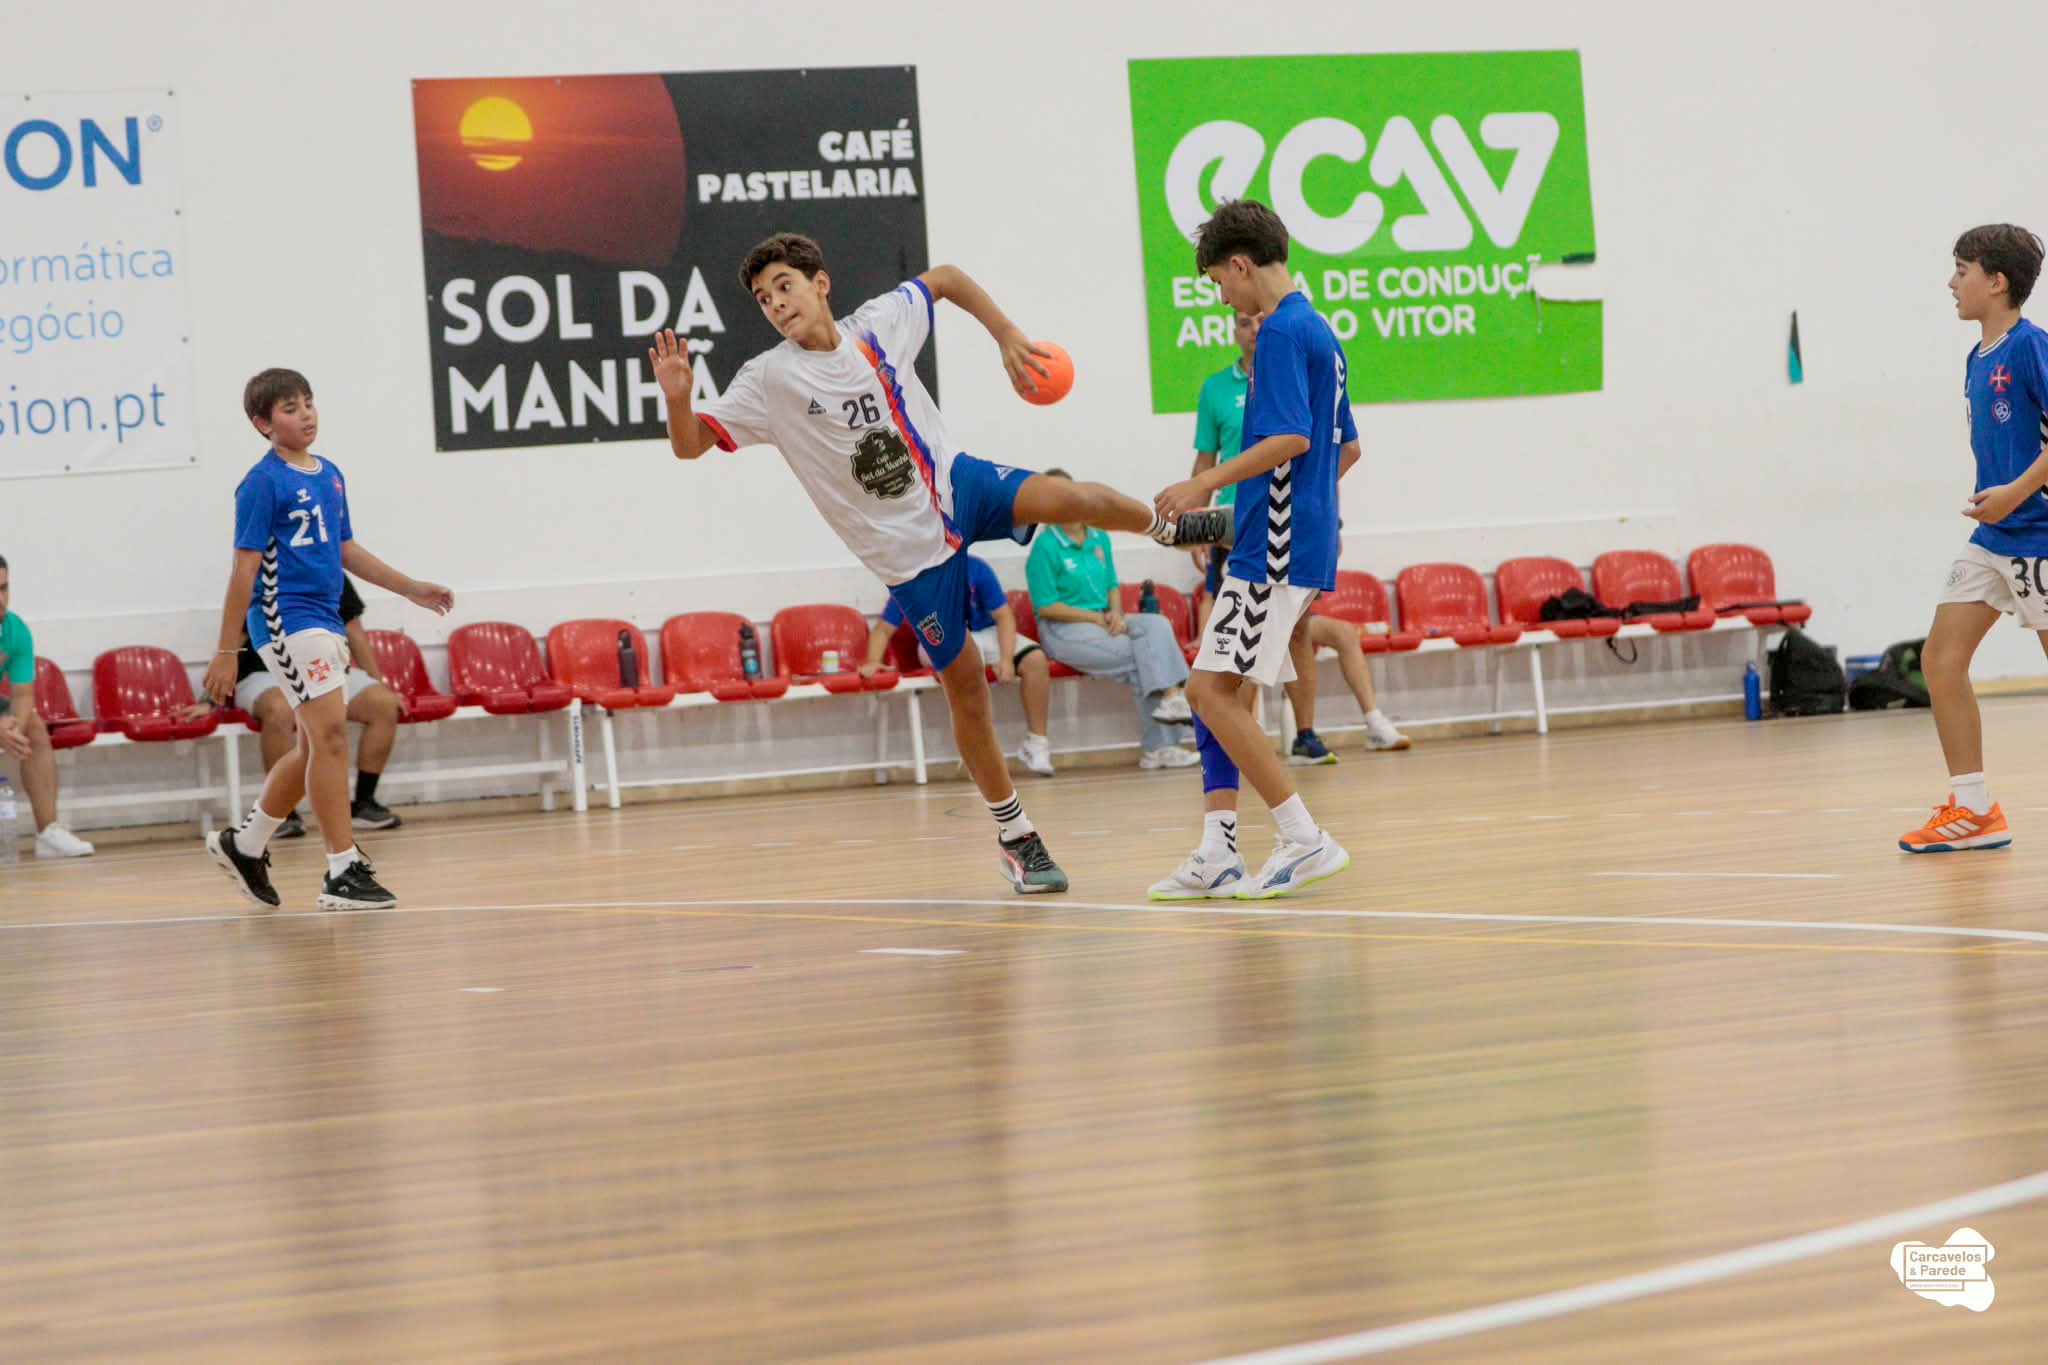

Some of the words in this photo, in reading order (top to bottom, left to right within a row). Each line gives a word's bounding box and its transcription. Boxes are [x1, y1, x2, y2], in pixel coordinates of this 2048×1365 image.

[818, 119, 915, 162] CAFÉ
[697, 167, 918, 203] PASTELARIA
[441, 274, 593, 345] SOL
[618, 266, 726, 337] DA
[1323, 268, 1371, 301] DE
[0, 299, 124, 354] gócio
[1371, 304, 1477, 340] VITOR
[0, 383, 166, 444] ion.pt
[842, 393, 881, 430] 26
[287, 504, 329, 547] 21
